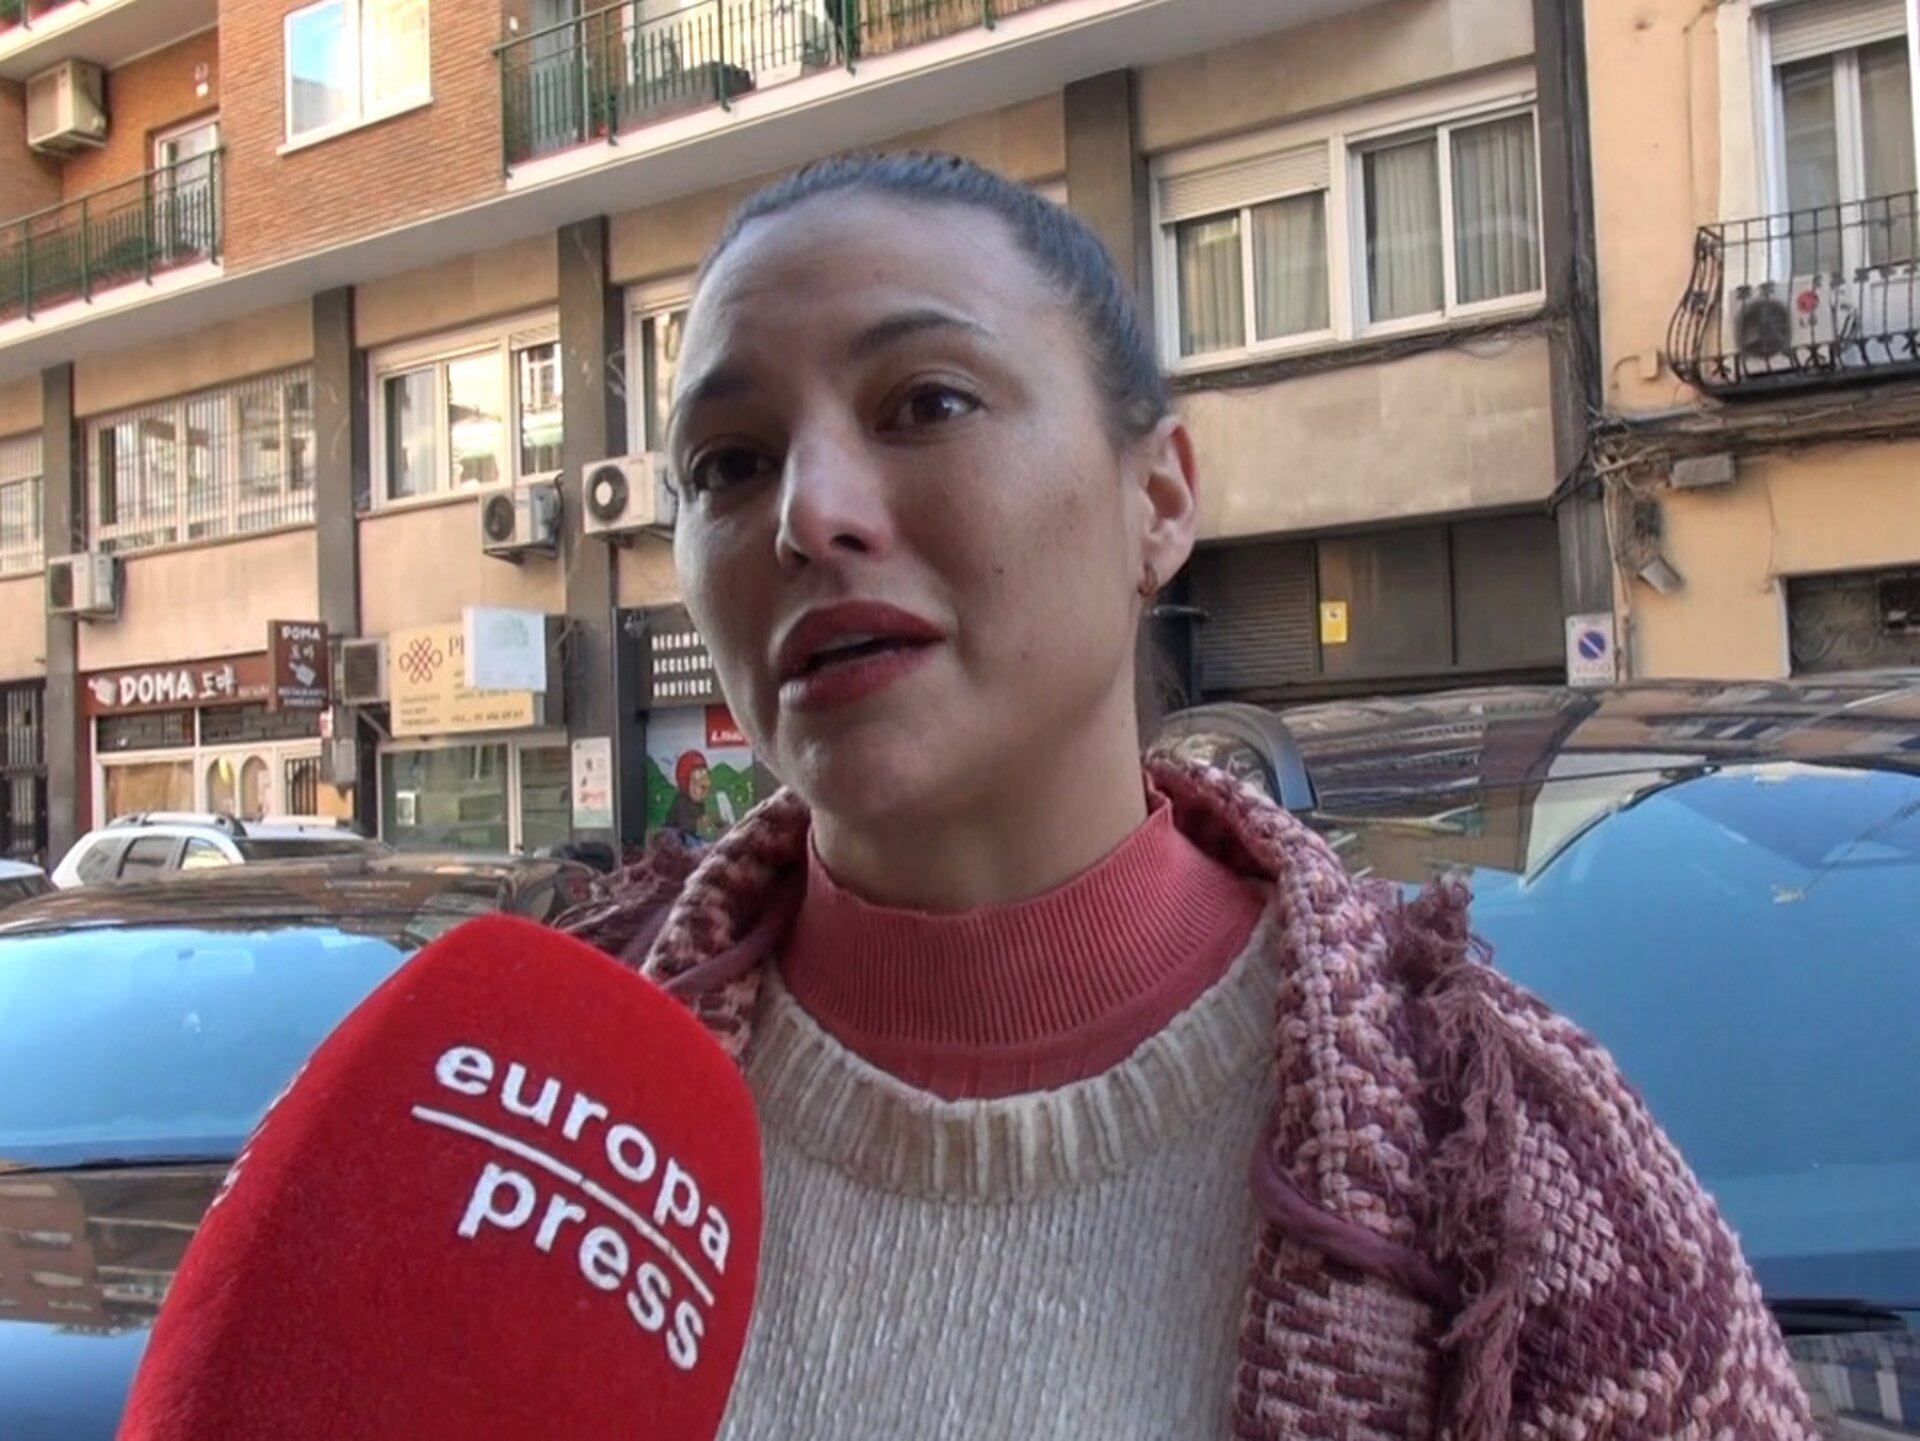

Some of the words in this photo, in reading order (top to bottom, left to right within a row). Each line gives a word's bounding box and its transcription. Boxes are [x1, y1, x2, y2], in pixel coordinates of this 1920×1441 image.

[281, 625, 321, 640] DOMA
[119, 670, 197, 706] DOMA
[653, 678, 712, 697] BOUTIQUE
[435, 1045, 730, 1275] europa
[457, 1162, 704, 1370] press
